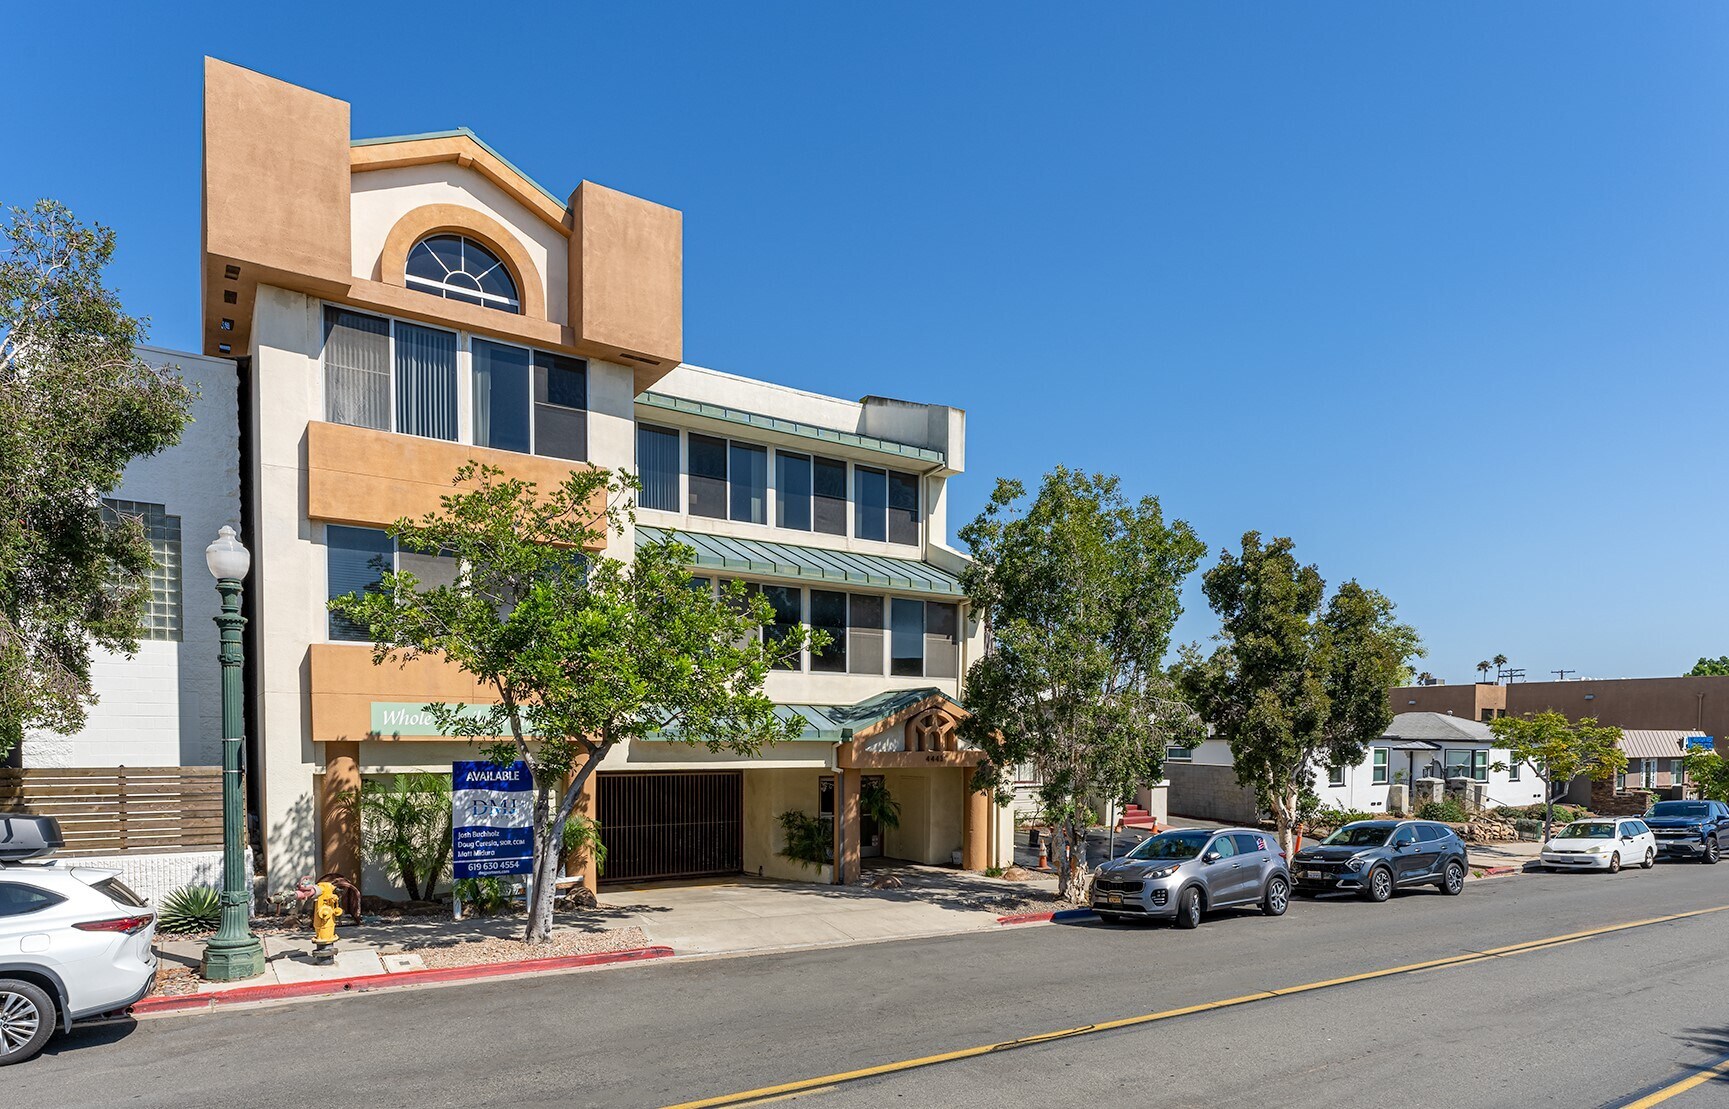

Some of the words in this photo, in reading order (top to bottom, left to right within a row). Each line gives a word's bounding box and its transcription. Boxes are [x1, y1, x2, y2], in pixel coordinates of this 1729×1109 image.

[383, 708, 432, 726] Whole
[466, 771, 520, 782] AVAILABLE
[457, 832, 472, 840] Josh
[472, 830, 500, 838] Buchholz
[457, 841, 475, 849] Doug
[457, 850, 472, 858] Matt
[468, 863, 482, 871] 619
[483, 862, 499, 870] 630
[500, 860, 520, 869] 4554
